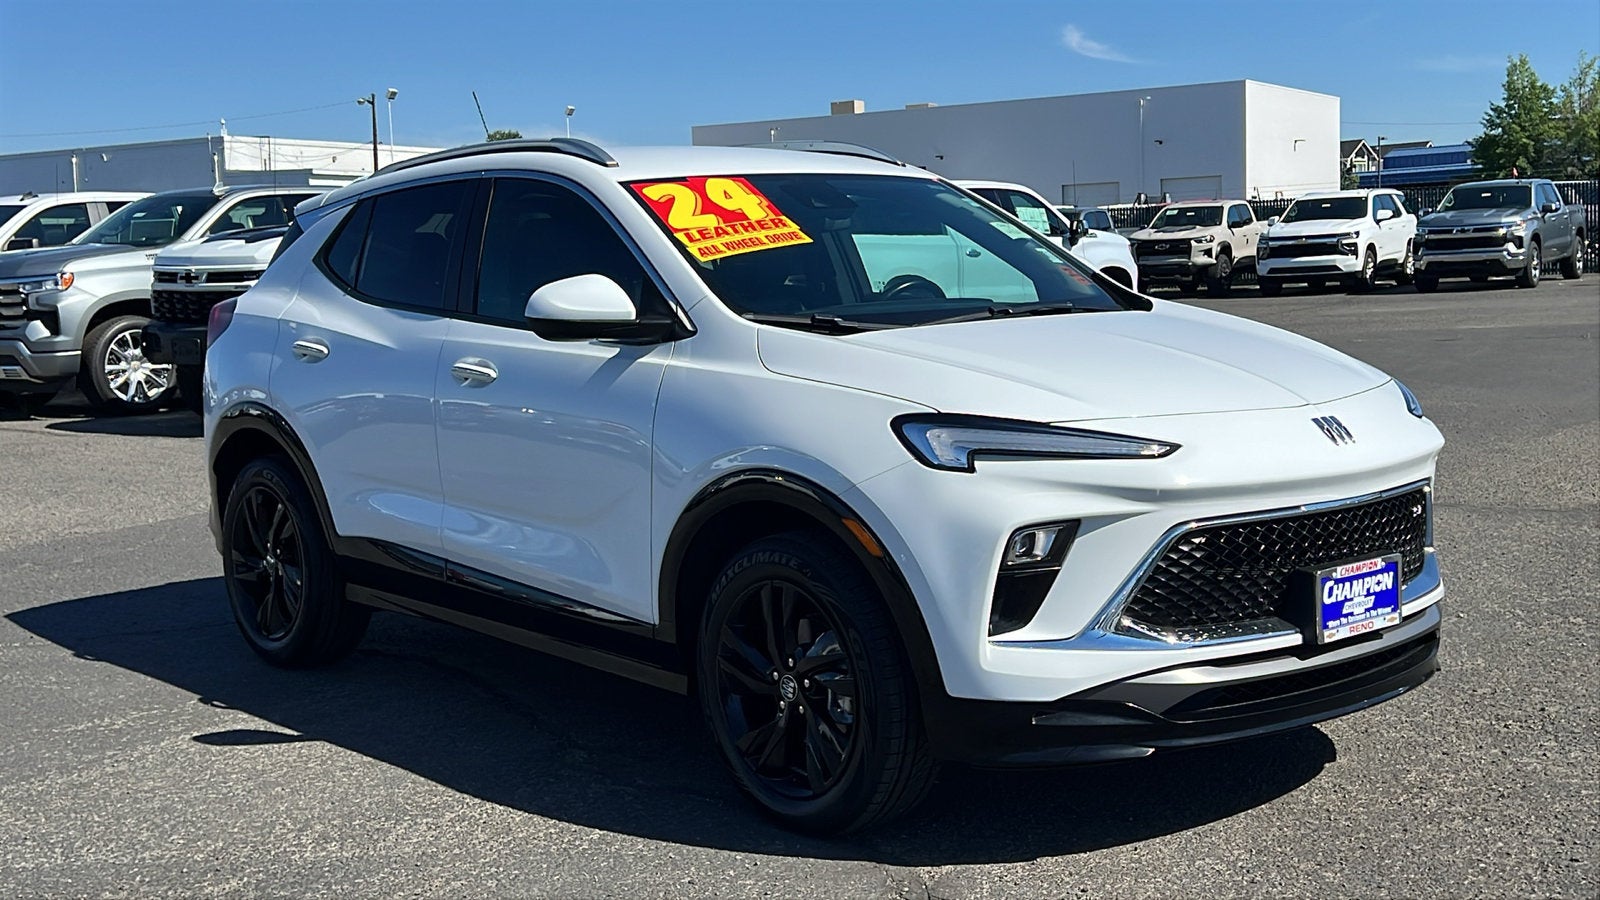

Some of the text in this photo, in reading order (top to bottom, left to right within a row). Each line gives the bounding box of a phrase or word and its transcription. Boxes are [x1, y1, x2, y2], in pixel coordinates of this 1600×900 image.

[642, 177, 776, 230] 24
[683, 217, 788, 243] LEATHER
[697, 230, 802, 258] ALL WHEEL DRIVE
[1340, 560, 1378, 576] CHAMPION
[1323, 571, 1394, 605] CHAMPION
[1345, 599, 1372, 611] CHEVROLET
[1349, 621, 1374, 633] RENO
